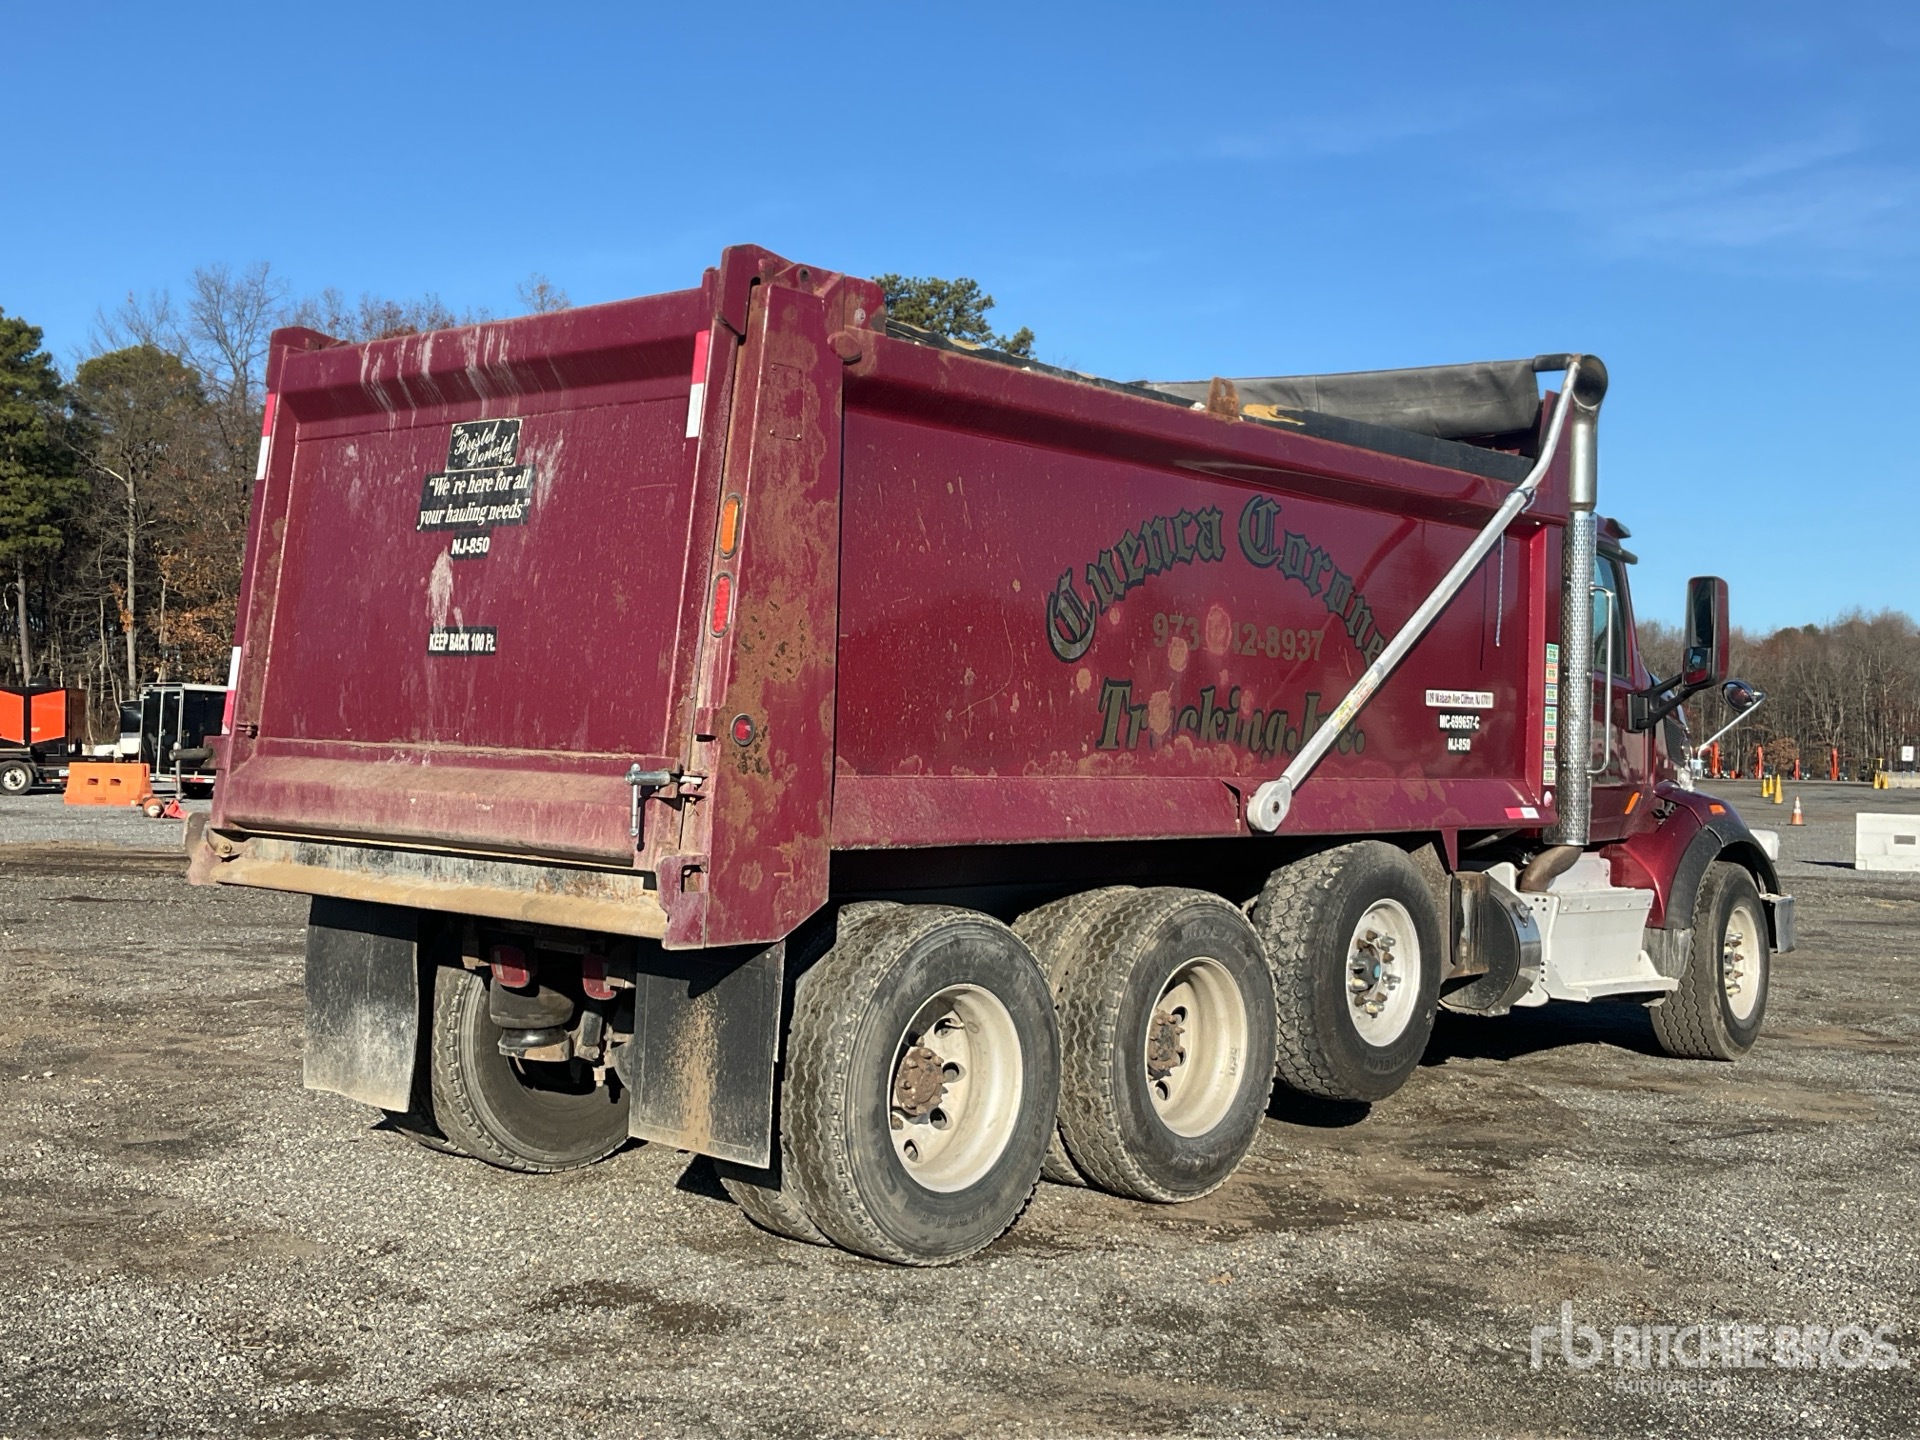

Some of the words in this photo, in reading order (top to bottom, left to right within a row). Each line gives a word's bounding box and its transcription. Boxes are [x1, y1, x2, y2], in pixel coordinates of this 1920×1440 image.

[454, 421, 499, 456] Bristol
[467, 432, 515, 467] Donald
[466, 474, 492, 494] here
[494, 471, 513, 491] for
[513, 469, 531, 490] all
[416, 510, 445, 530] your
[445, 502, 489, 526] hauling
[451, 536, 491, 555] NJ-850
[1046, 504, 1226, 664] Cuenca
[428, 632, 449, 651] KEEP
[448, 632, 470, 651] BACK
[470, 632, 485, 651] 100
[1448, 737, 1471, 751] NJ-850
